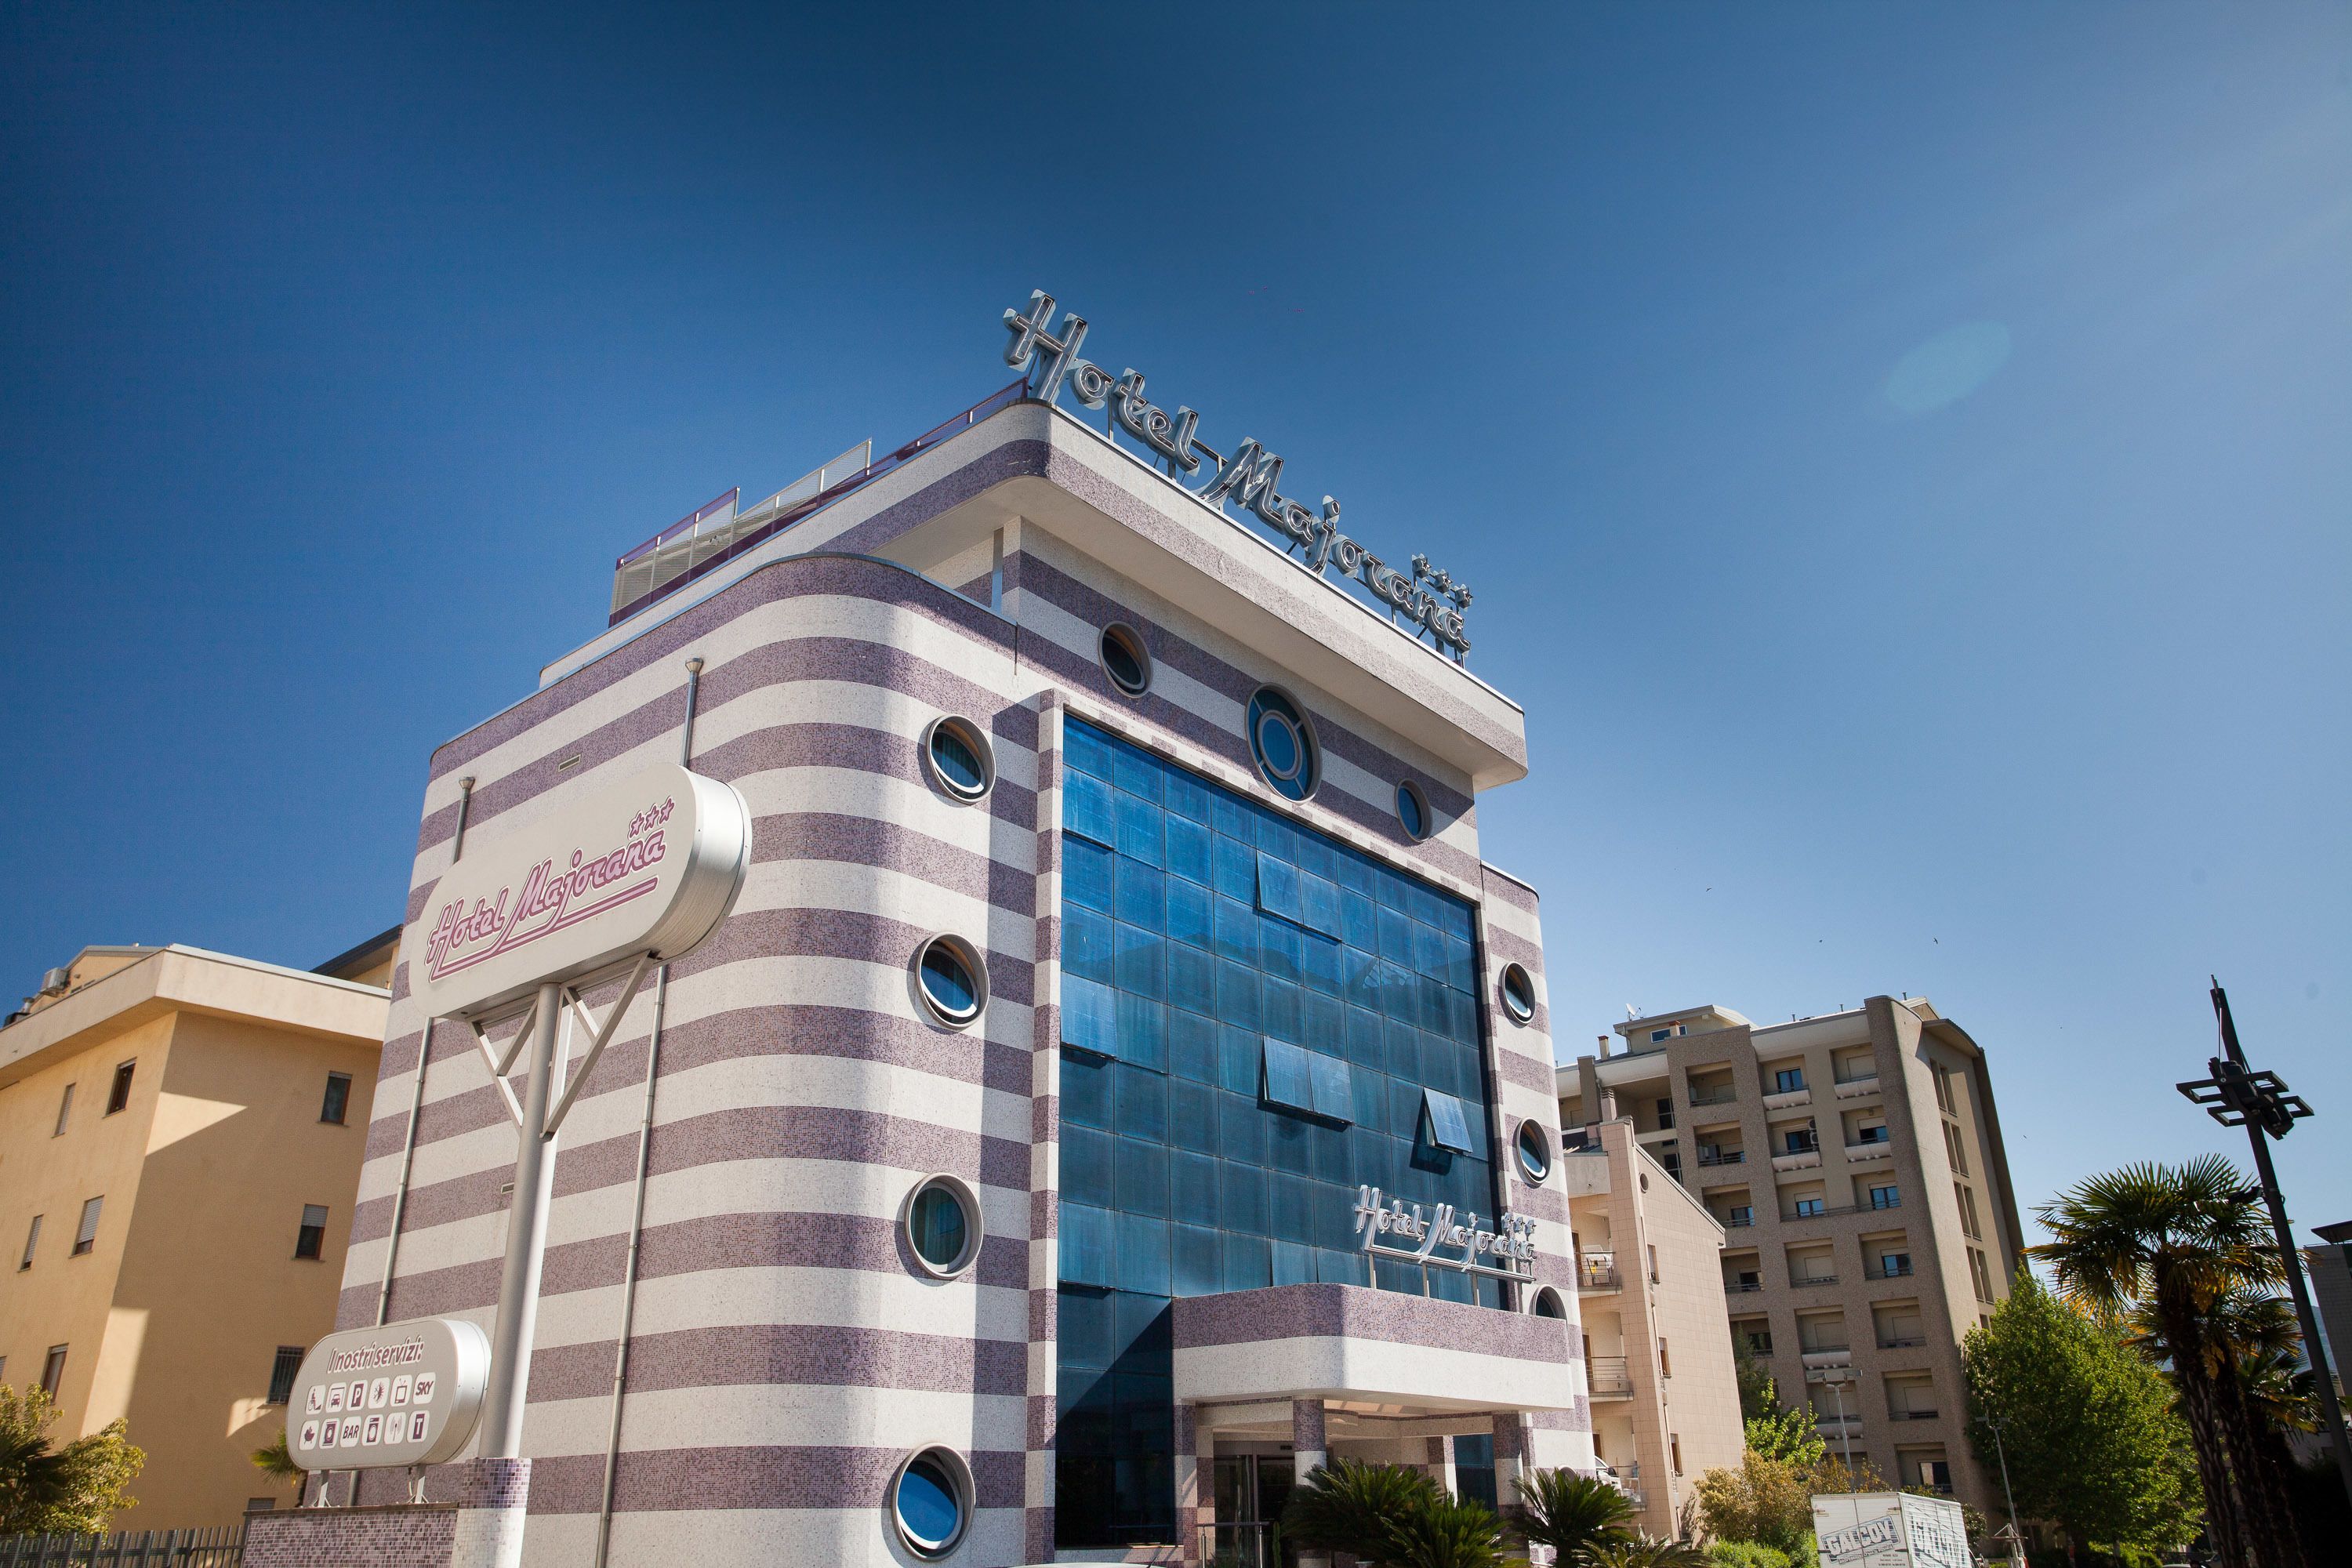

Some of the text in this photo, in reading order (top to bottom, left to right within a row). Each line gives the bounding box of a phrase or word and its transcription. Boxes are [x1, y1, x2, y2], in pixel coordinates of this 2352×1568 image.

[1004, 289, 1472, 657] Hotel Majorana
[424, 829, 667, 983] Hotel Majorana
[1354, 1184, 1537, 1266] Hotel Majorana
[335, 1341, 376, 1372] nostri
[373, 1335, 425, 1368] servizi:
[354, 1388, 362, 1405] P
[416, 1381, 434, 1396] SKY
[343, 1425, 360, 1439] BAR
[416, 1417, 424, 1436] T
